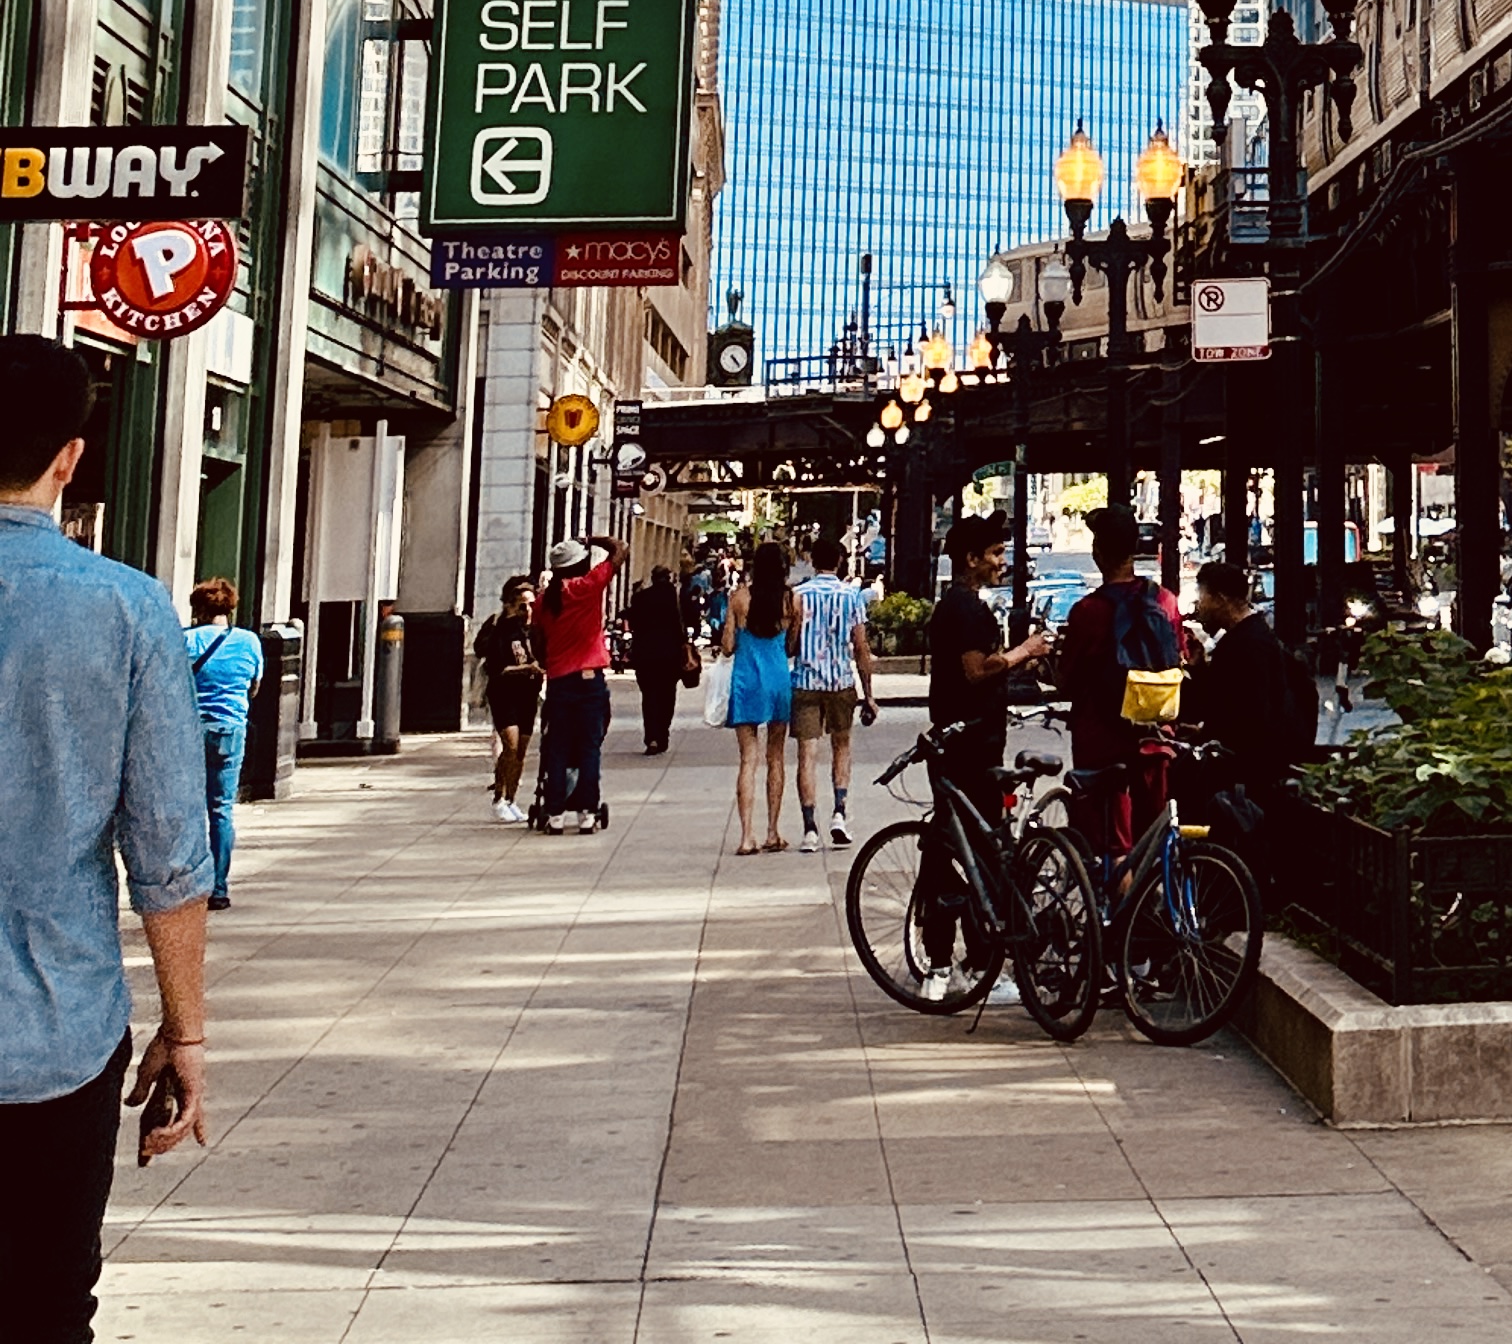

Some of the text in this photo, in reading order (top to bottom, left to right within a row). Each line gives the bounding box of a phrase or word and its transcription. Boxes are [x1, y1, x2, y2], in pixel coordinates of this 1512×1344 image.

[478, 0, 630, 51] SELF
[474, 62, 649, 114] PARK
[0, 141, 226, 199] BWAY
[442, 241, 543, 260] Theatre
[585, 238, 671, 265] macy's
[444, 262, 540, 285] Parking
[561, 268, 675, 281] DISCOUNT PARKING
[100, 286, 218, 332] KITCHEN
